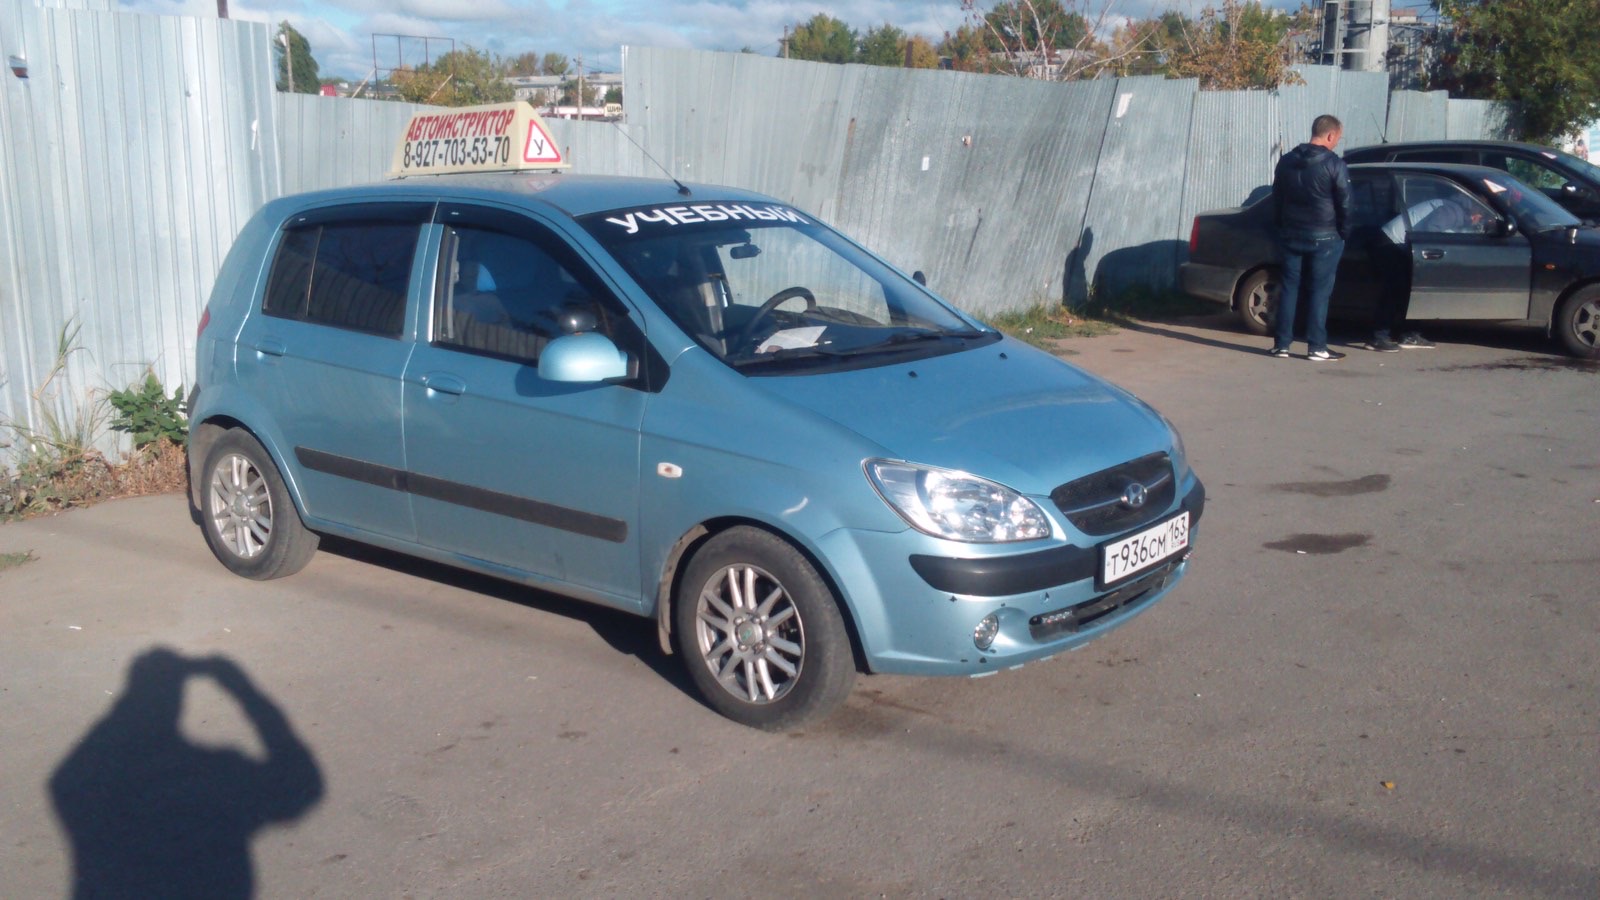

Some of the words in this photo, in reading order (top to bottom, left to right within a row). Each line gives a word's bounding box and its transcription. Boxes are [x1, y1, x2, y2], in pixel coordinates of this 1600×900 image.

[405, 109, 515, 141] АВТОИНСТРУКТОР
[403, 136, 510, 168] 8-927-703-53-70
[533, 139, 544, 155] У
[606, 205, 809, 233] УЧЕБНЫЙ
[1169, 516, 1186, 541] 163
